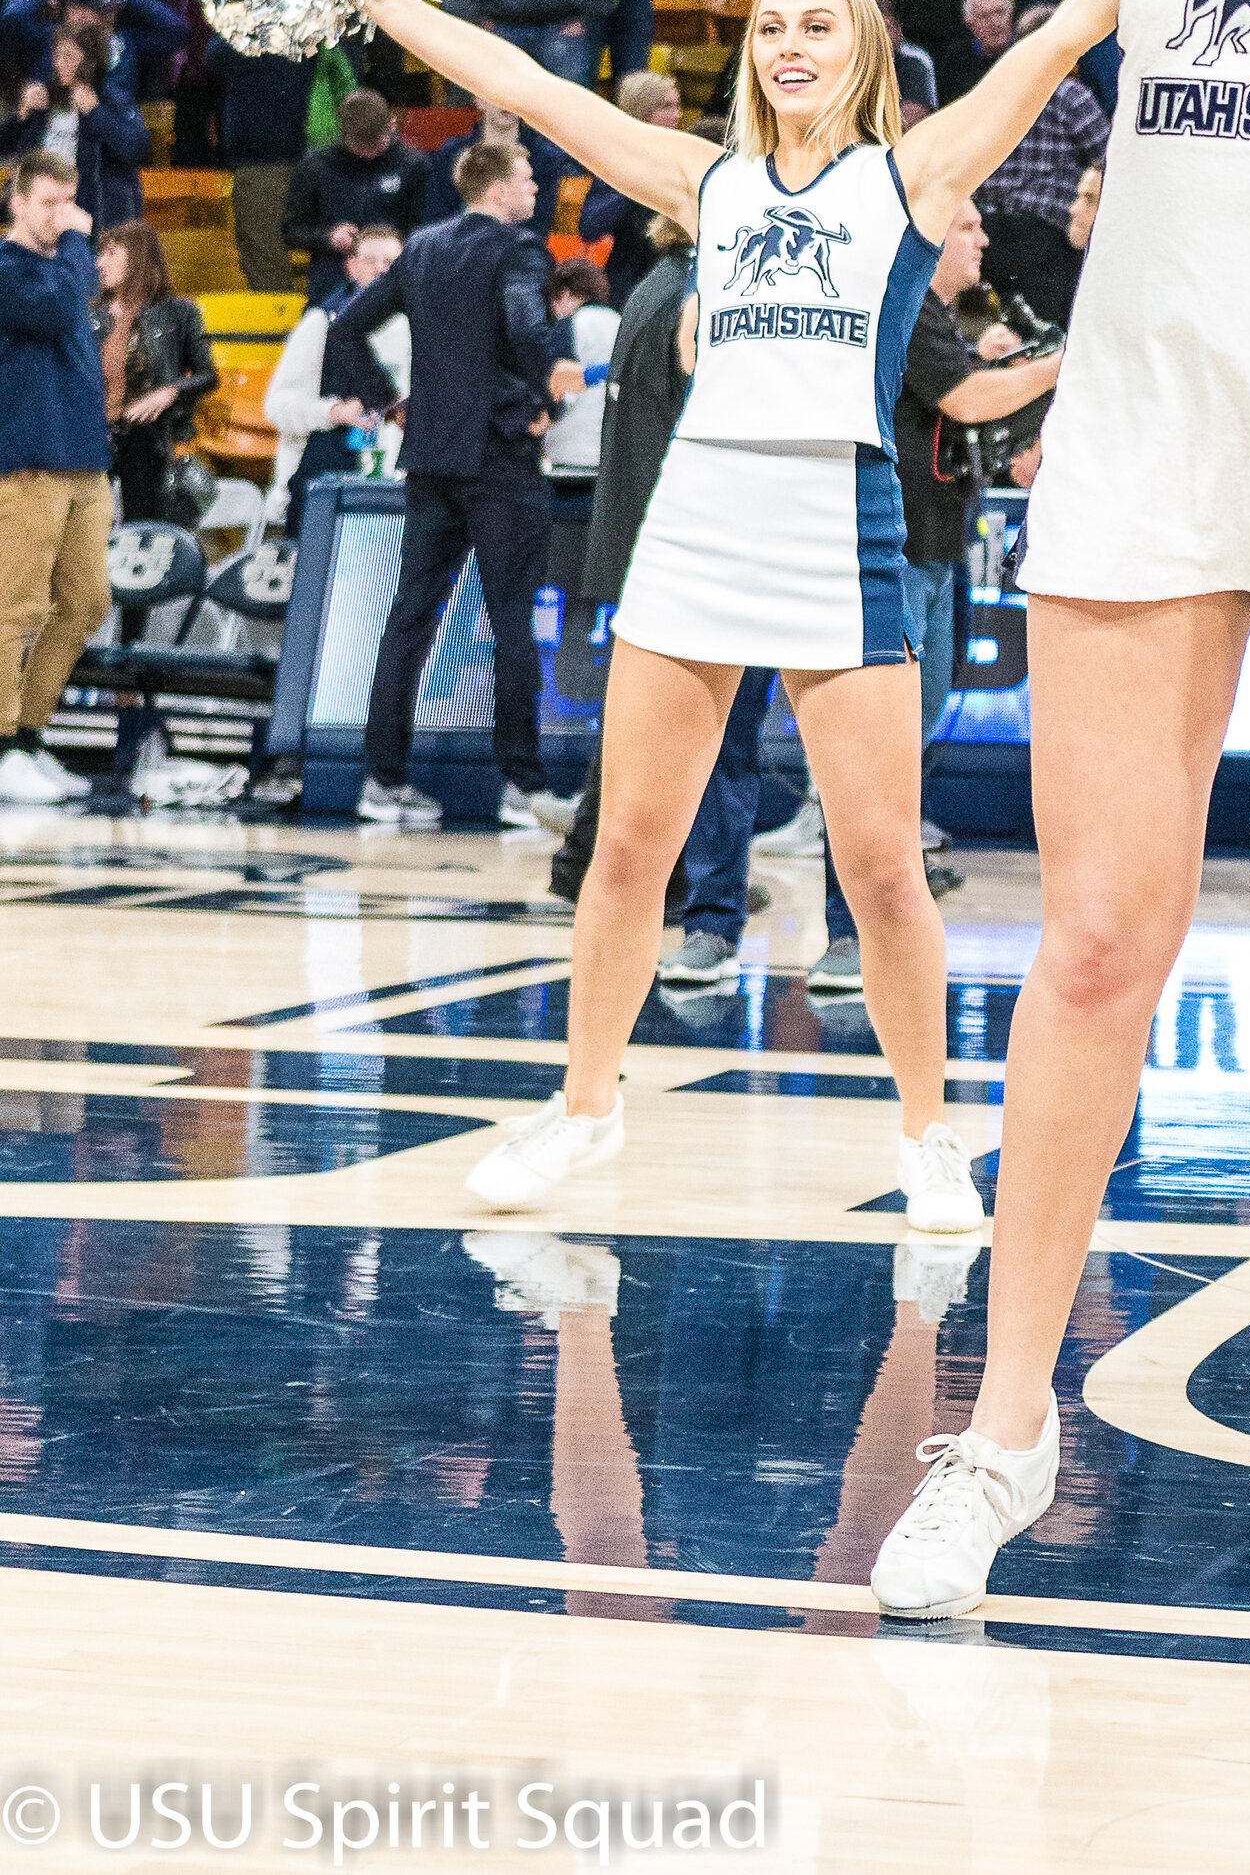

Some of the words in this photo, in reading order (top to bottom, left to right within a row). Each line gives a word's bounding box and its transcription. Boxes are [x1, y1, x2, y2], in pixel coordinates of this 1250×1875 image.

[1136, 77, 1241, 138] UTAH
[710, 303, 778, 347] UTAH
[777, 303, 871, 348] STATE
